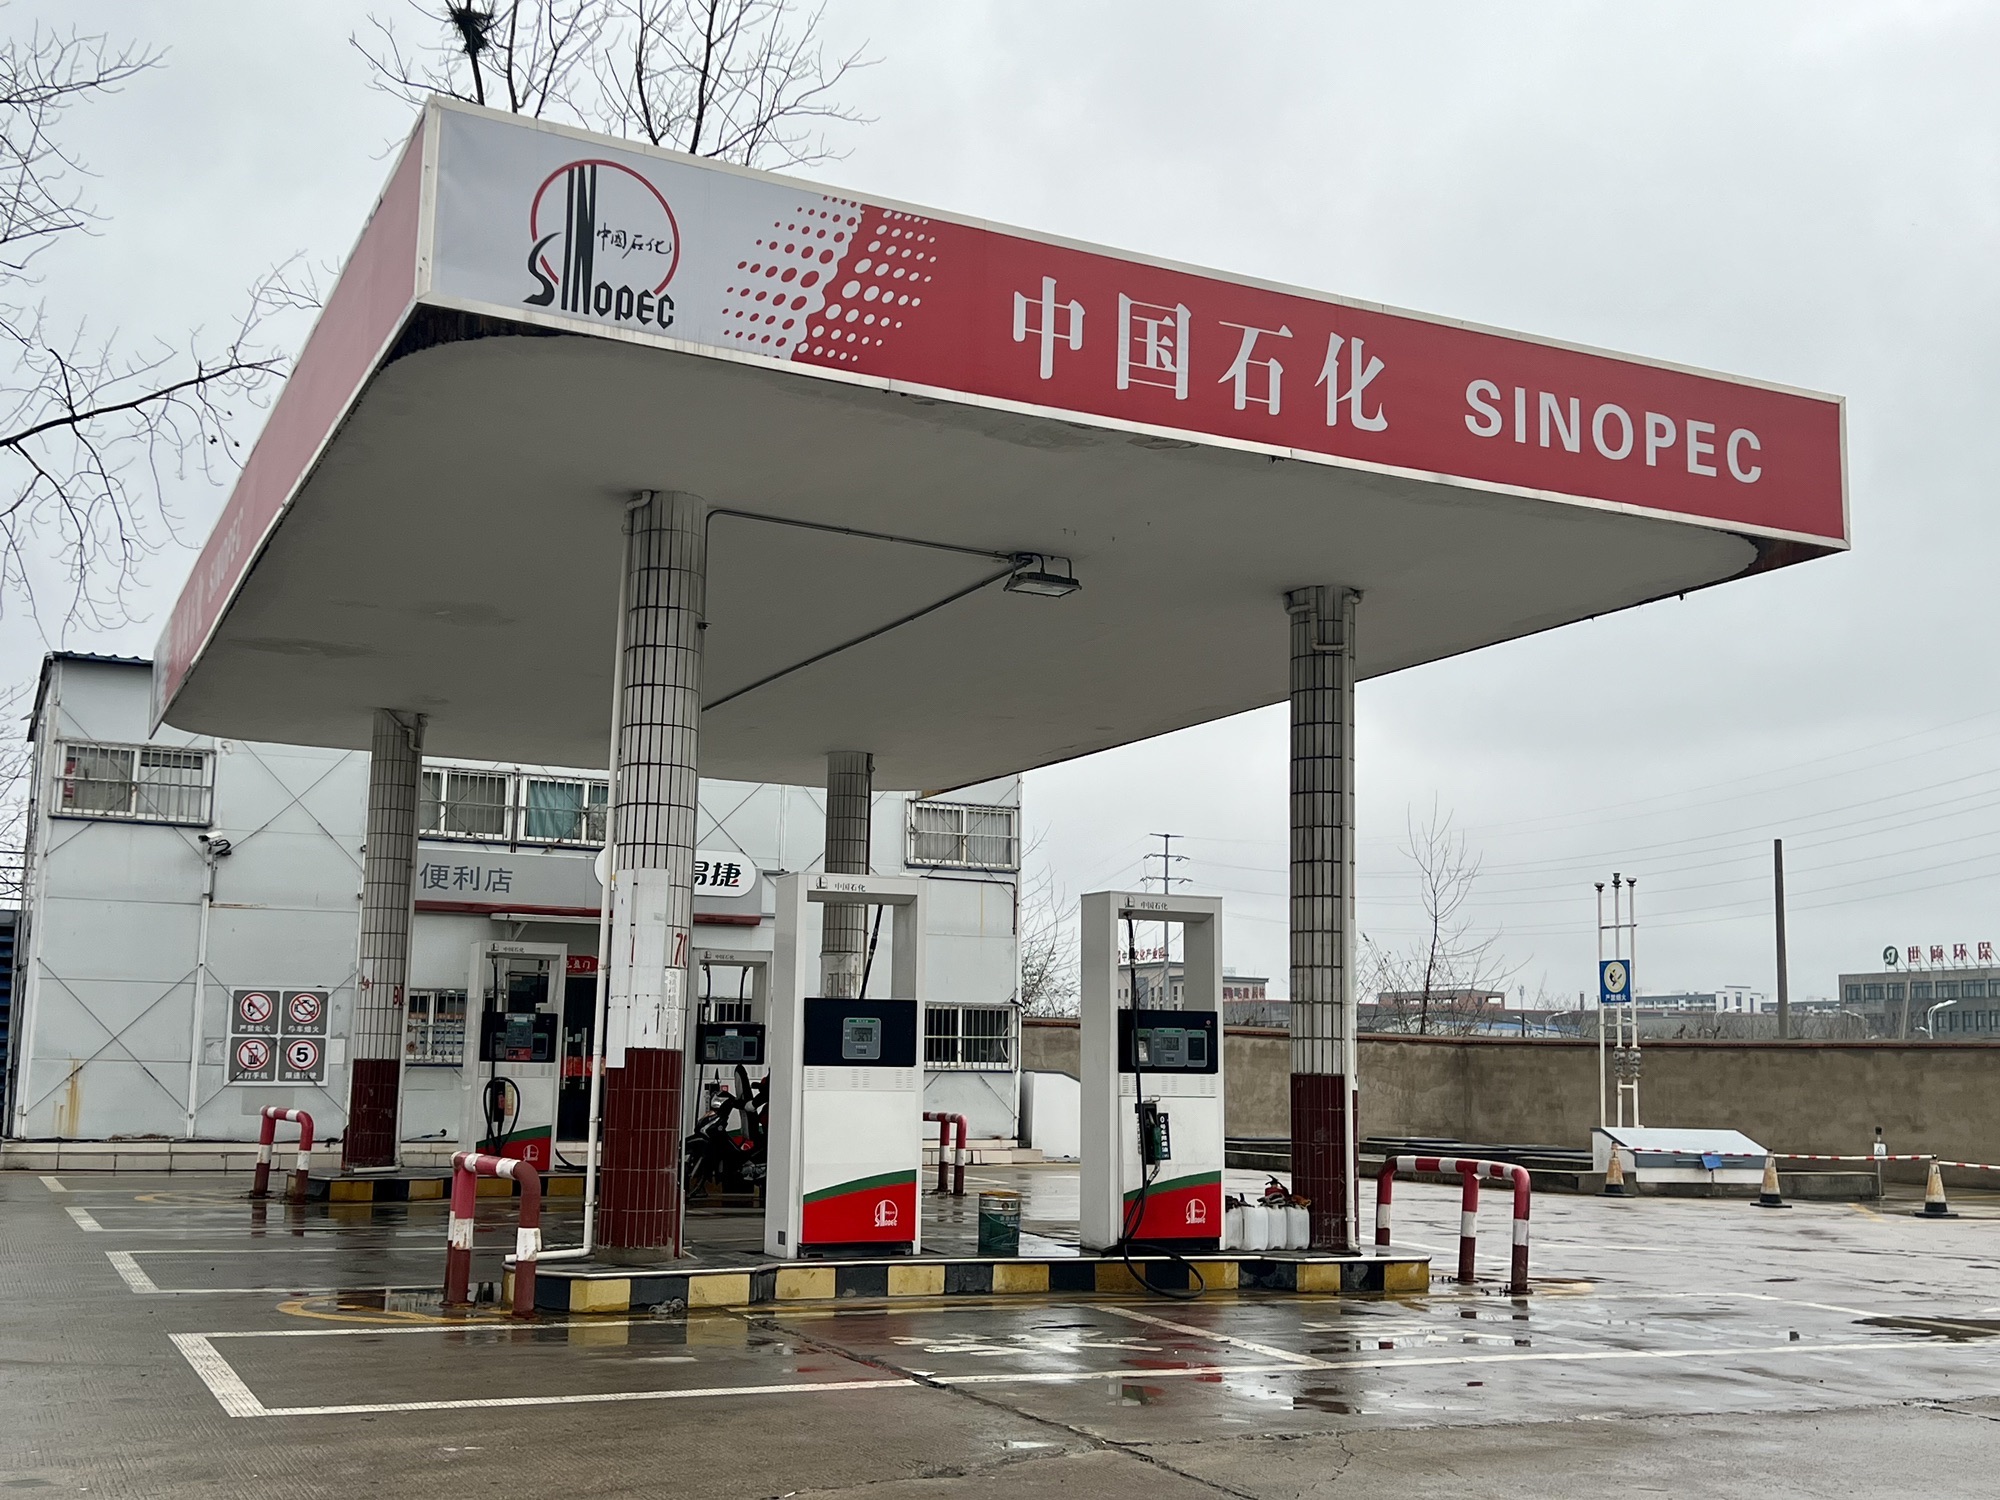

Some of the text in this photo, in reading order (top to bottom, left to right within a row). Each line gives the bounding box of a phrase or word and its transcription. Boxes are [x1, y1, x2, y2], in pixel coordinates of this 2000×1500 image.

[523, 163, 675, 329] SINOPEC
[1012, 275, 1763, 484] 中国石化 SINOPEC
[419, 862, 514, 894] 便利店
[834, 882, 866, 892] 中国石化
[1140, 901, 1168, 910] 中国石化
[295, 1047, 309, 1063] 5
